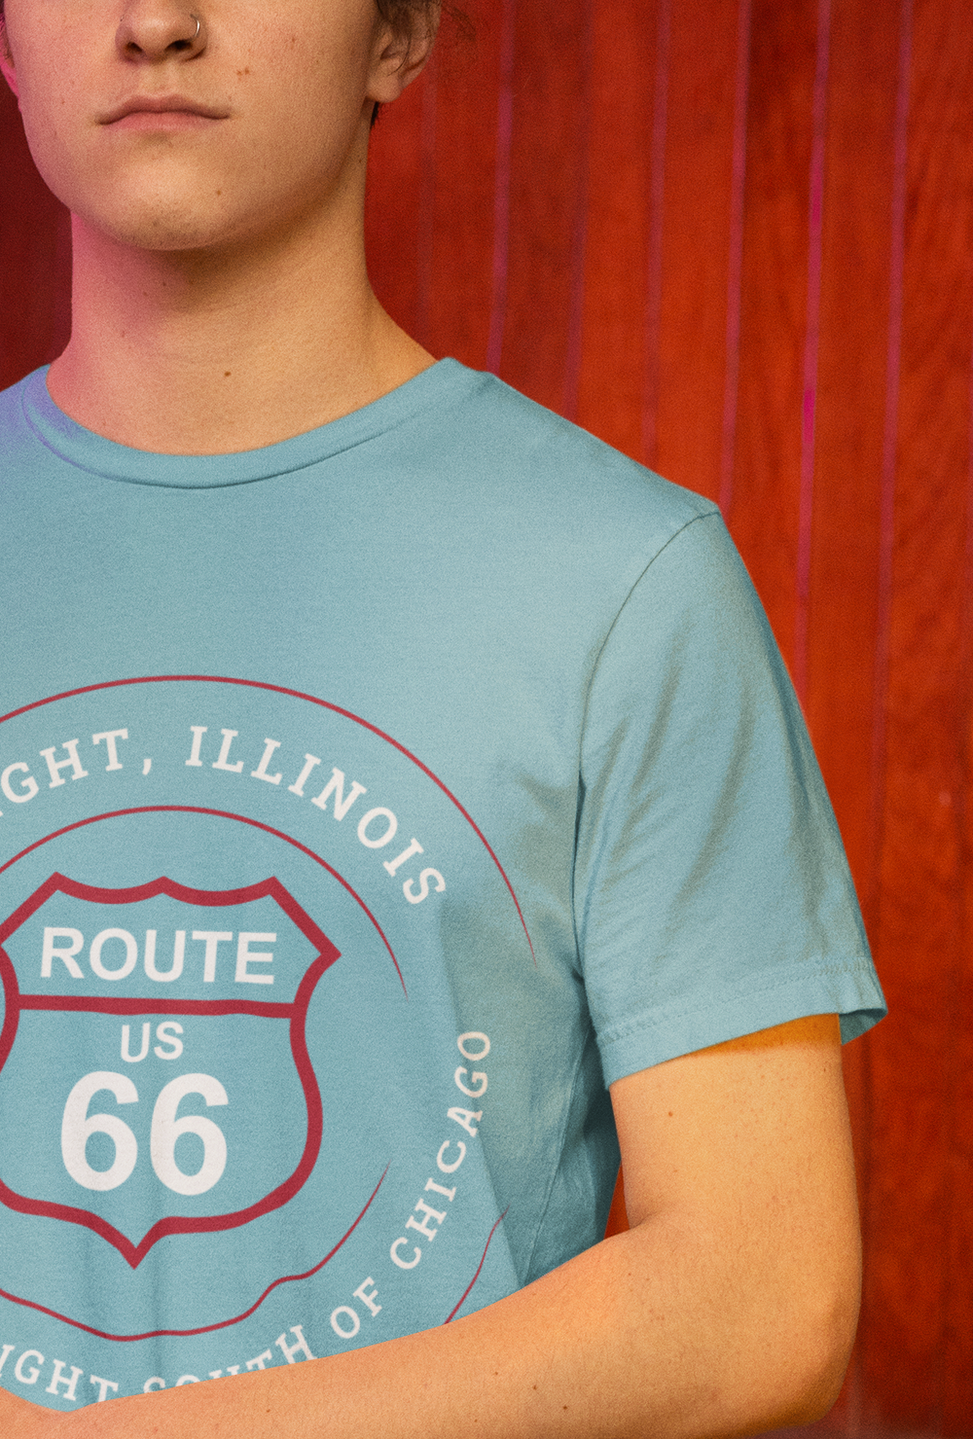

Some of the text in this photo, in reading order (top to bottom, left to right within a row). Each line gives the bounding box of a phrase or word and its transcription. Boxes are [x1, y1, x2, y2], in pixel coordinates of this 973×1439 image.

[185, 725, 447, 905] ILLINOIS
[39, 926, 278, 985] ROUTE
[119, 1021, 185, 1063] US
[60, 1070, 230, 1196] 66
[329, 1276, 382, 1340] OF
[389, 1030, 492, 1271] CHICAGO
